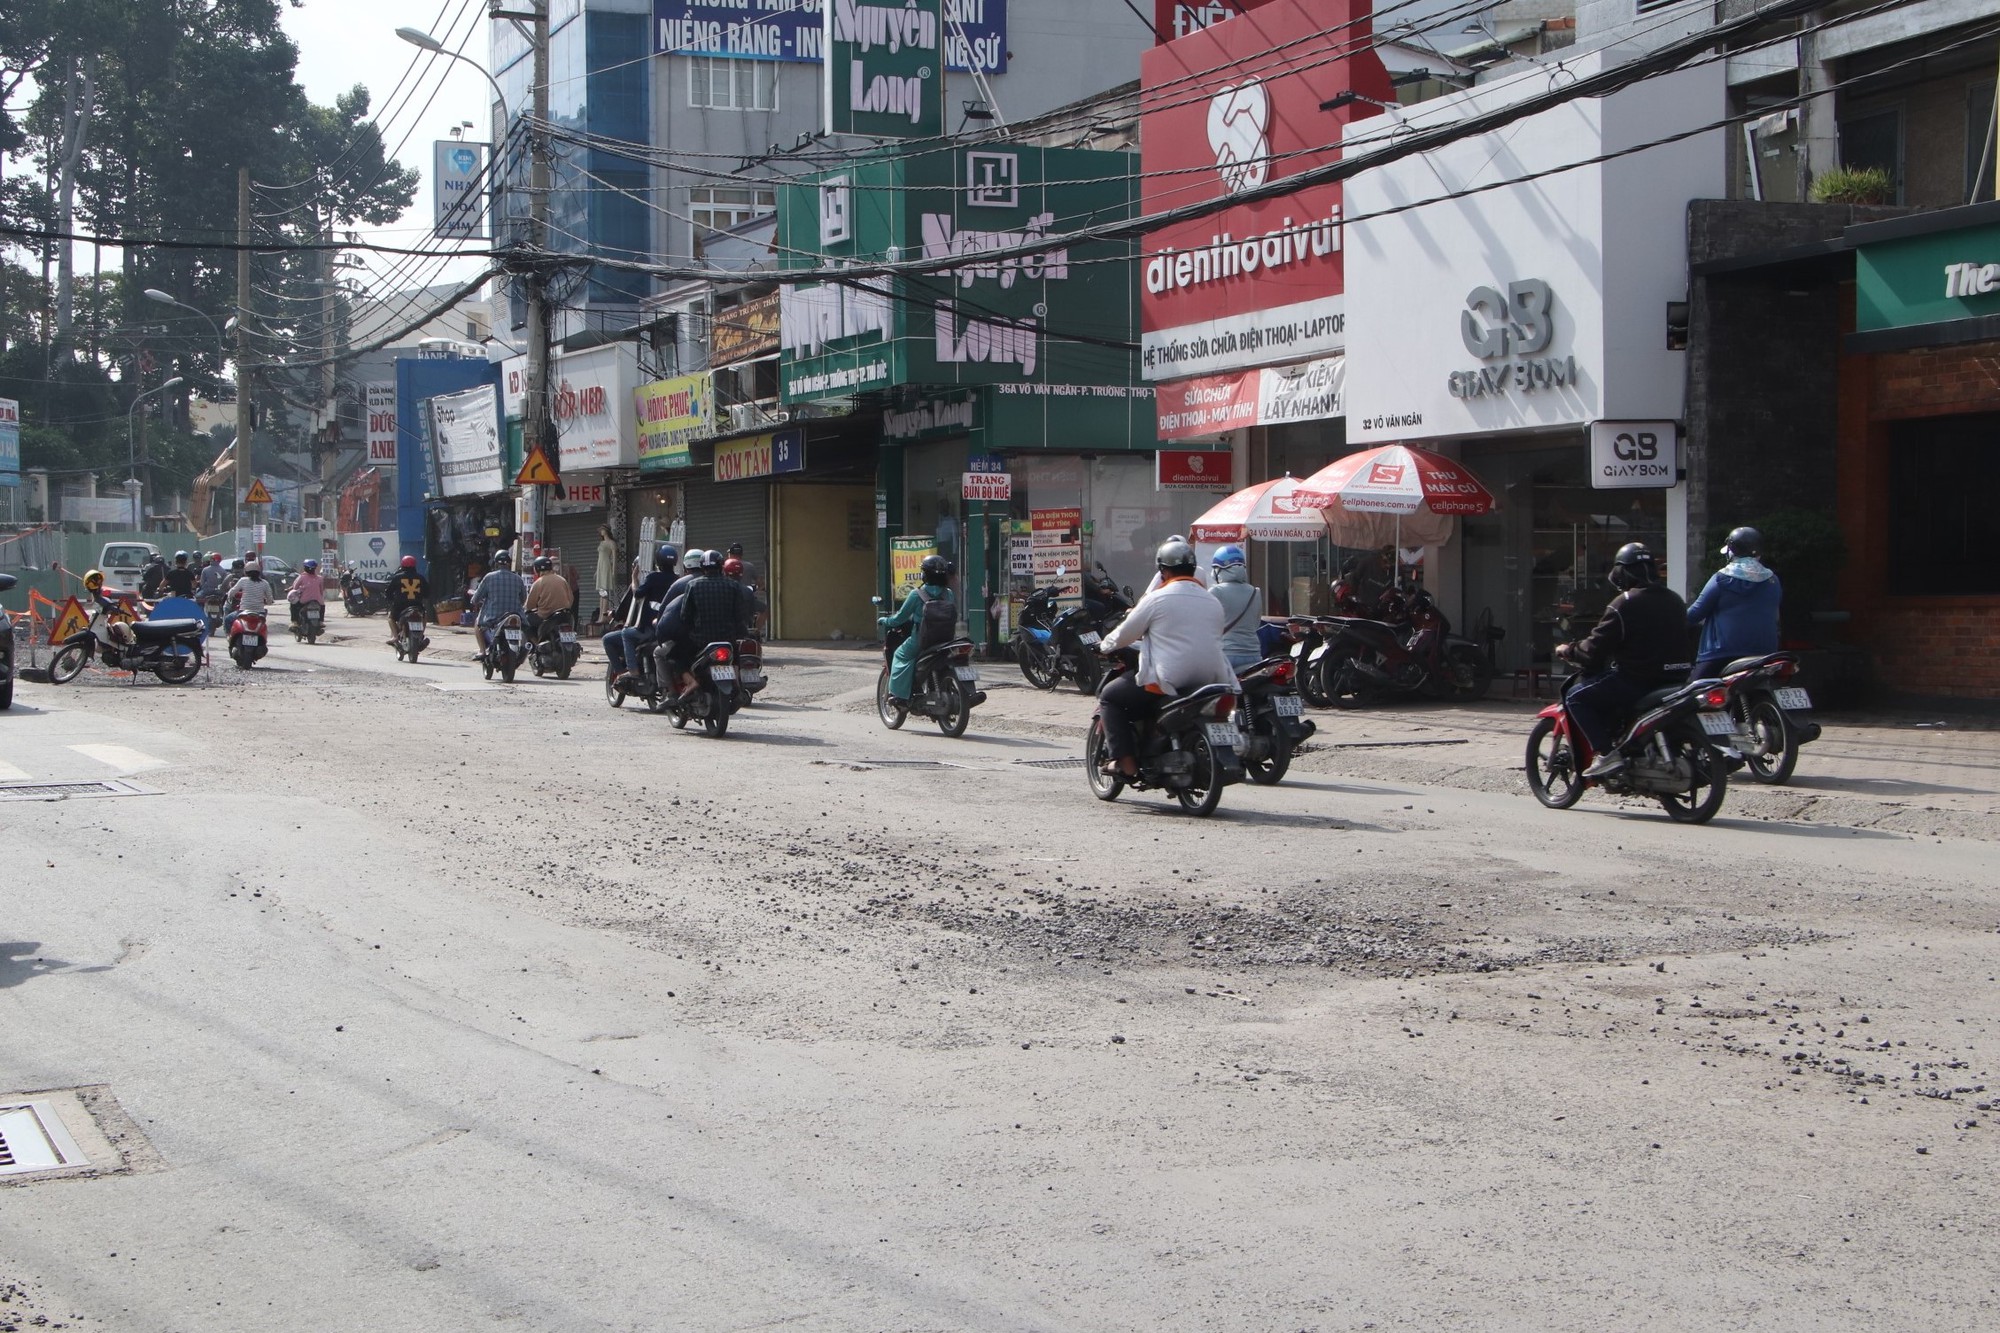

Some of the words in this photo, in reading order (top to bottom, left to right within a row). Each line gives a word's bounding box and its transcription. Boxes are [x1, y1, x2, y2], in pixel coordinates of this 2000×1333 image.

[660, 10, 720, 52] NIỀNG
[727, 16, 781, 56] RĂNG
[974, 32, 1001, 69] SỨ
[850, 60, 921, 124] Long
[445, 180, 473, 191] NHA
[1146, 204, 1341, 294] dienthoaivui
[1945, 263, 1999, 298] The
[1461, 278, 1553, 359] GB
[935, 300, 1037, 376] Long
[1143, 345, 1155, 370] HỆ
[1157, 339, 1188, 364] THỐNG
[1190, 336, 1209, 358] SỬA
[1211, 331, 1238, 355] CHỮA
[1240, 327, 1263, 353] ĐIỆN
[1265, 322, 1297, 347] THOẠI
[999, 384, 1016, 395] 36A
[1306, 364, 1336, 392] KIỆM
[580, 386, 606, 416] HER
[647, 388, 668, 422] HỒNG
[669, 386, 690, 418] PHÚC
[1291, 391, 1341, 418] NHANH
[370, 410, 395, 433] ĐỨC
[437, 405, 456, 426] Shop
[1159, 412, 1180, 433] ĐIỆN
[1181, 409, 1207, 429] THOẠI
[1211, 403, 1233, 423] MÁY
[1233, 401, 1254, 417] TÍNH
[1362, 419, 1372, 430] 32
[1374, 416, 1384, 430] VÕ
[1385, 414, 1401, 428] VĂN
[1401, 412, 1423, 427] NGÂN
[370, 440, 396, 459] ANH
[718, 449, 742, 480] CƠM
[745, 436, 770, 477] TẤM
[778, 440, 789, 462] 35
[1613, 432, 1658, 461] GB
[991, 462, 1002, 472] 34
[1427, 471, 1458, 481] THU
[970, 475, 1005, 485] TRANG
[1426, 480, 1455, 493] MÁY
[1457, 481, 1478, 494] CŨ
[569, 485, 601, 501] HER
[1342, 498, 1417, 510] cellphones.com.vn
[896, 540, 933, 549] TRANG
[1259, 529, 1268, 537] VÕ
[360, 560, 388, 569] NHA
